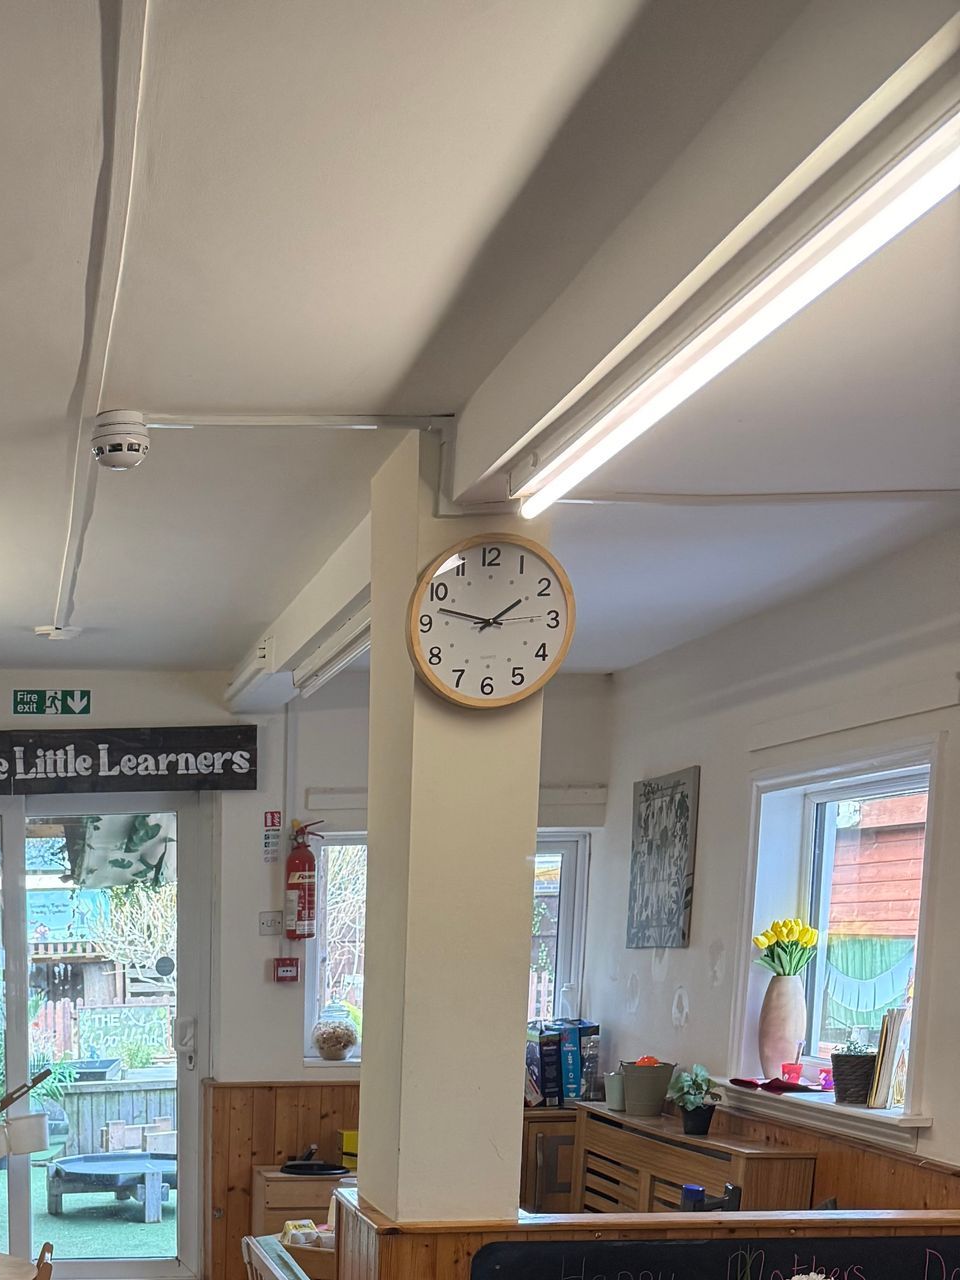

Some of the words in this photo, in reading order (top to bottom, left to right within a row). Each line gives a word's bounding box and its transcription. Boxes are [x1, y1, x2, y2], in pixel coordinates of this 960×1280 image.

[482, 547, 501, 567] 12
[520, 554, 524, 574] 1
[430, 582, 448, 602] 10
[537, 577, 551, 597] 2
[420, 614, 433, 633] 9
[546, 610, 560, 629] 3
[428, 646, 442, 666] 8
[535, 642, 548, 662] 4
[452, 669, 466, 688] 7
[480, 676, 494, 695] 6
[511, 666, 525, 686] 5
[16, 692, 38, 702] Fire
[16, 703, 37, 712] exit
[13, 744, 93, 779] Little
[98, 744, 251, 777] Learners
[91, 1014, 120, 1028] THE
